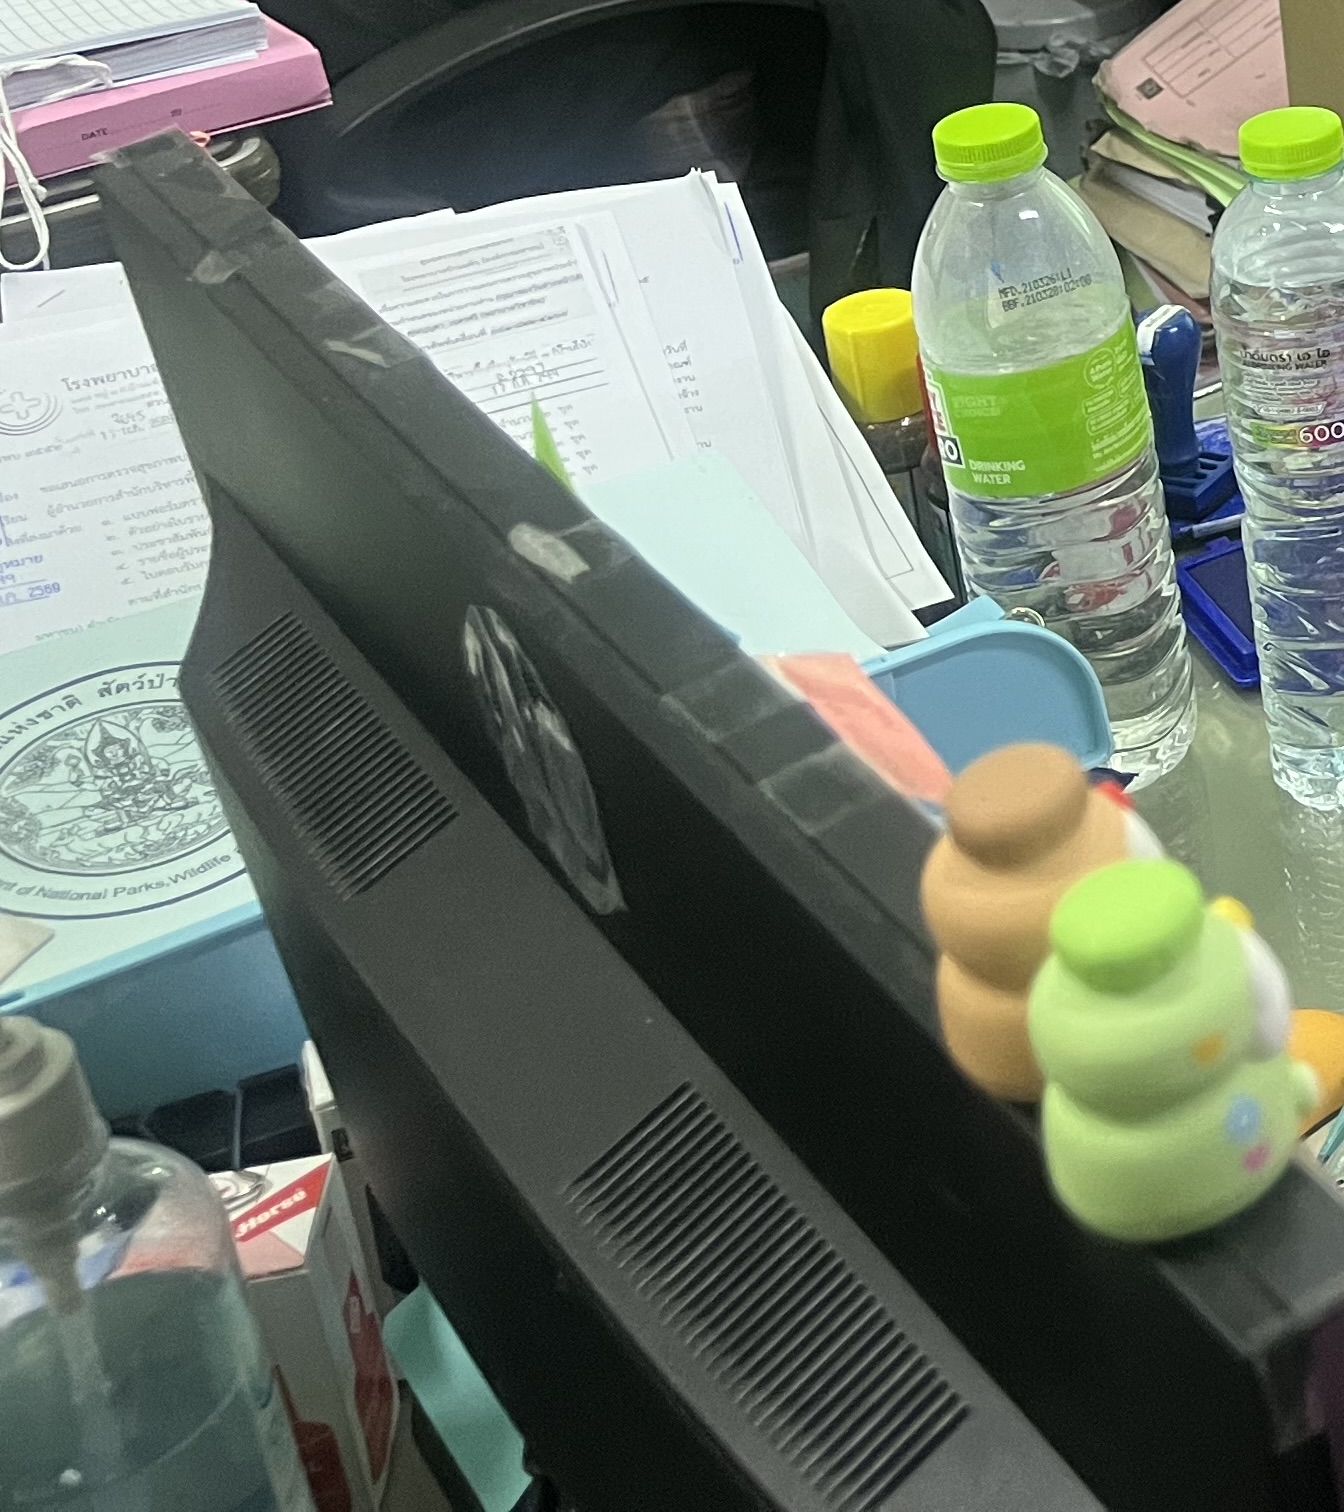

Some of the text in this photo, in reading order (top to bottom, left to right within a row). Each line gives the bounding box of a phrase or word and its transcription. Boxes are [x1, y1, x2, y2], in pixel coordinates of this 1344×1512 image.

[81, 128, 109, 141] DATE
[968, 458, 1026, 472] DRINKING
[971, 471, 1012, 485] WATER
[0, 672, 178, 750] แห่งชาติ สัตว์ป่า
[33, 884, 108, 902] National
[235, 1187, 308, 1239] Horse
